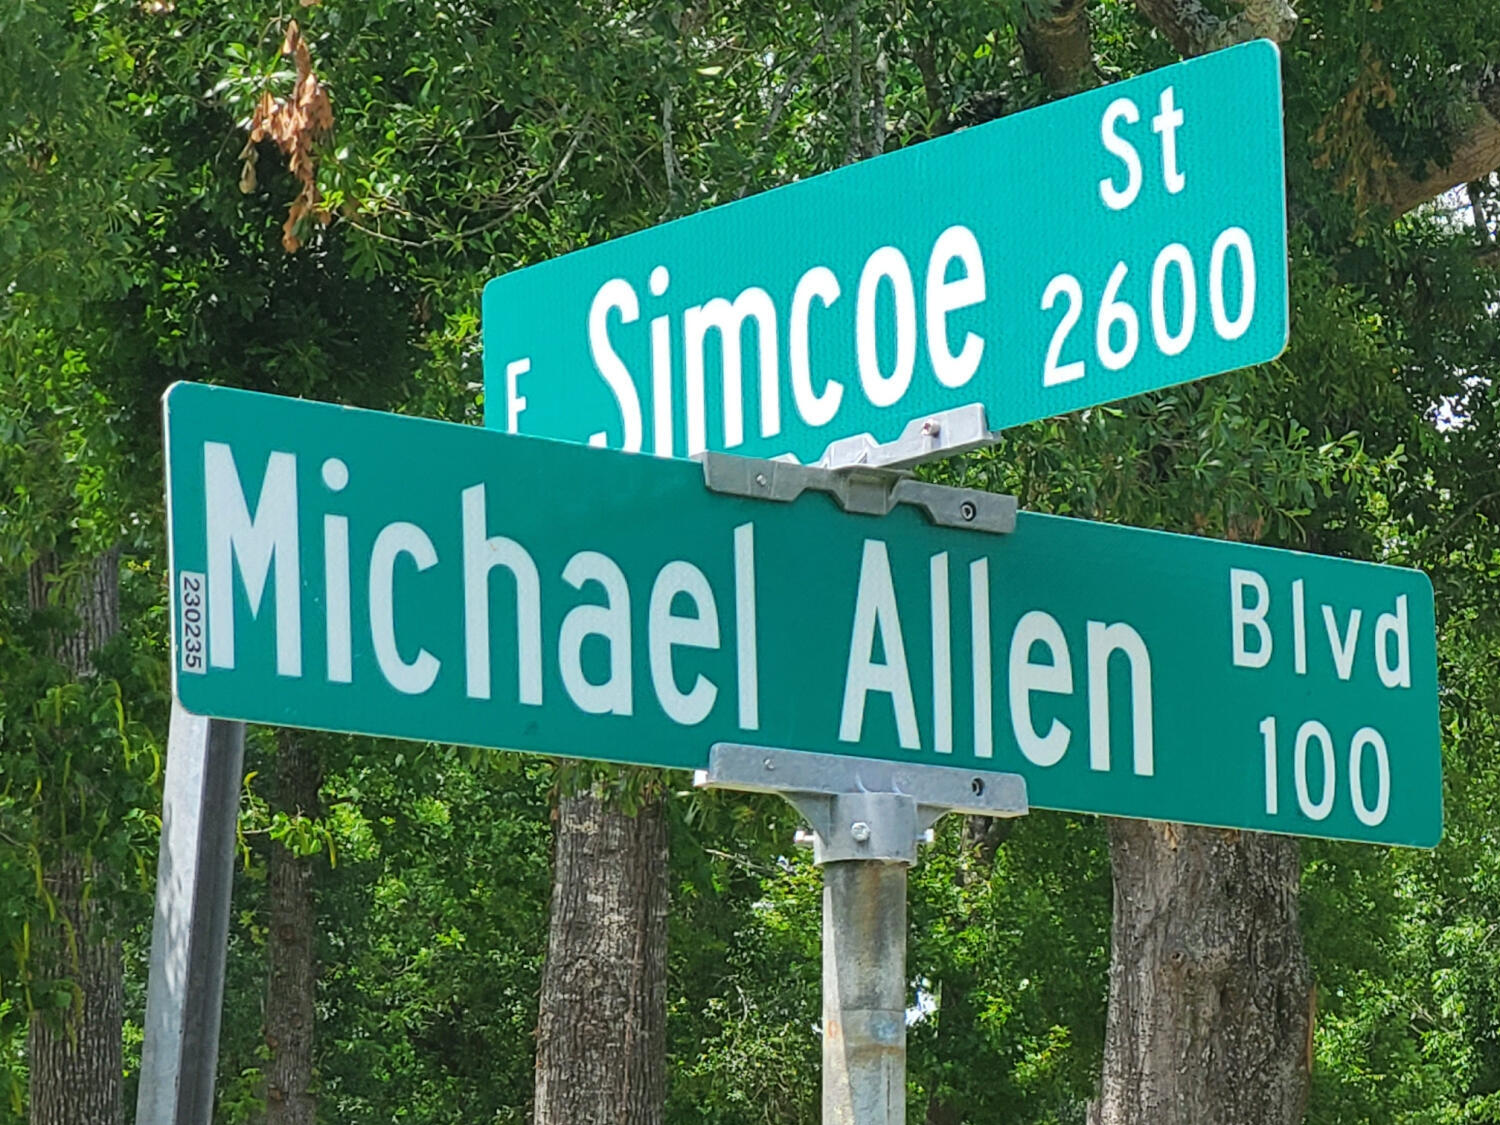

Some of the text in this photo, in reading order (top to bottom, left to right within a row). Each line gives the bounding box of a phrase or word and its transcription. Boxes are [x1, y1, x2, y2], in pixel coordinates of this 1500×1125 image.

[1099, 86, 1186, 211] St
[588, 225, 987, 460] Simcoe
[1042, 226, 1256, 388] 2600
[184, 576, 202, 669] 230235
[204, 440, 1155, 776] Michael Allen
[1230, 568, 1411, 688] Blvd
[1259, 716, 1391, 827] 100
